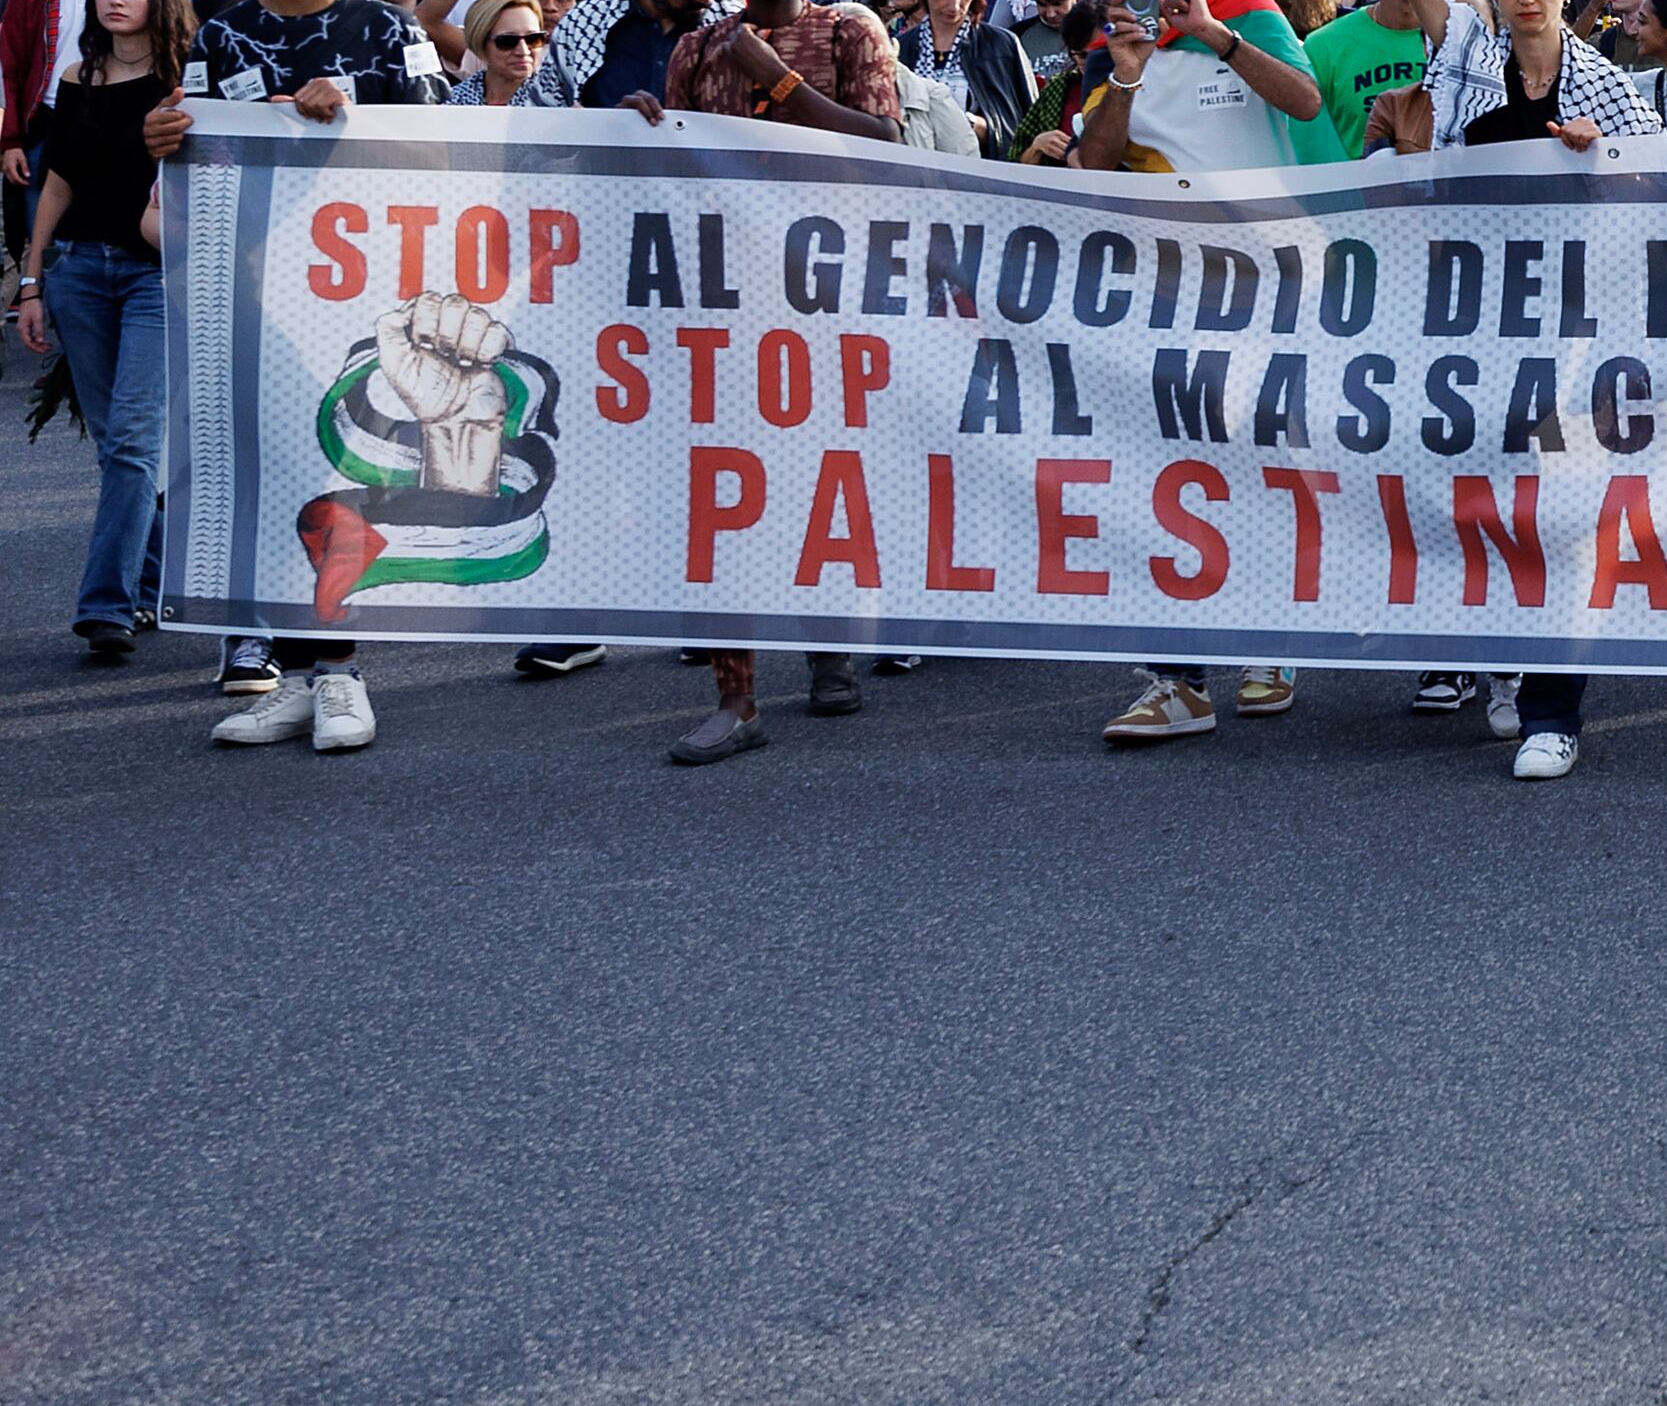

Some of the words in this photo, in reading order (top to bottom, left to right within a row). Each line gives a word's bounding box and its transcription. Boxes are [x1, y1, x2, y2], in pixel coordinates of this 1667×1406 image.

[1199, 84, 1220, 95] FREE
[1199, 94, 1246, 107] PALESTINE
[307, 201, 581, 304] STOP
[626, 212, 741, 310] AL
[784, 216, 1378, 337] GENOCIDIO
[1422, 239, 1598, 338] DEL
[595, 323, 892, 429] STOP
[958, 337, 1094, 436] AL
